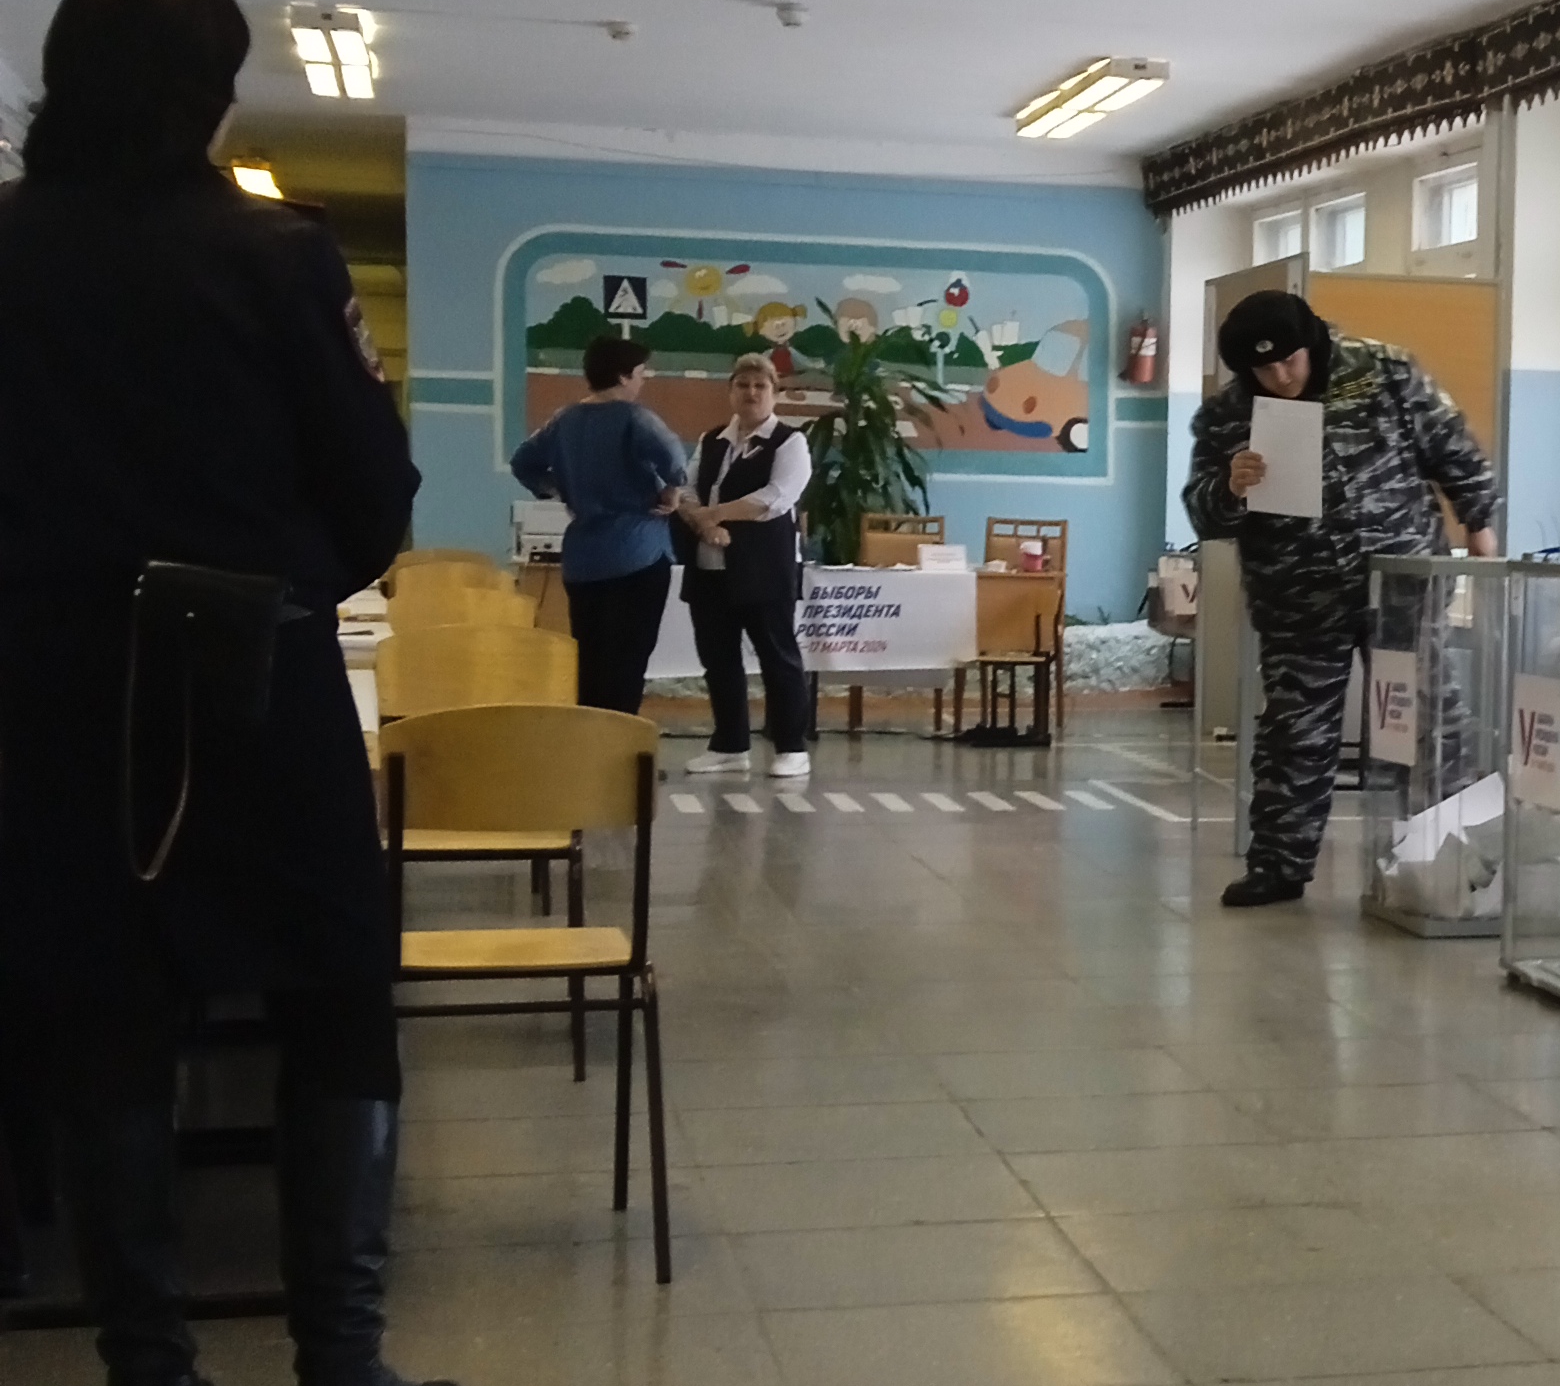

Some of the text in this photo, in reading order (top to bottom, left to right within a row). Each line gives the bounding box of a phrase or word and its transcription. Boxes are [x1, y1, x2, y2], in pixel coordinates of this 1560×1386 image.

[810, 586, 882, 600] ВЫБОРЫ
[802, 604, 901, 620] ПРЕЗИДЕНТА
[795, 623, 860, 638] РОССИИ
